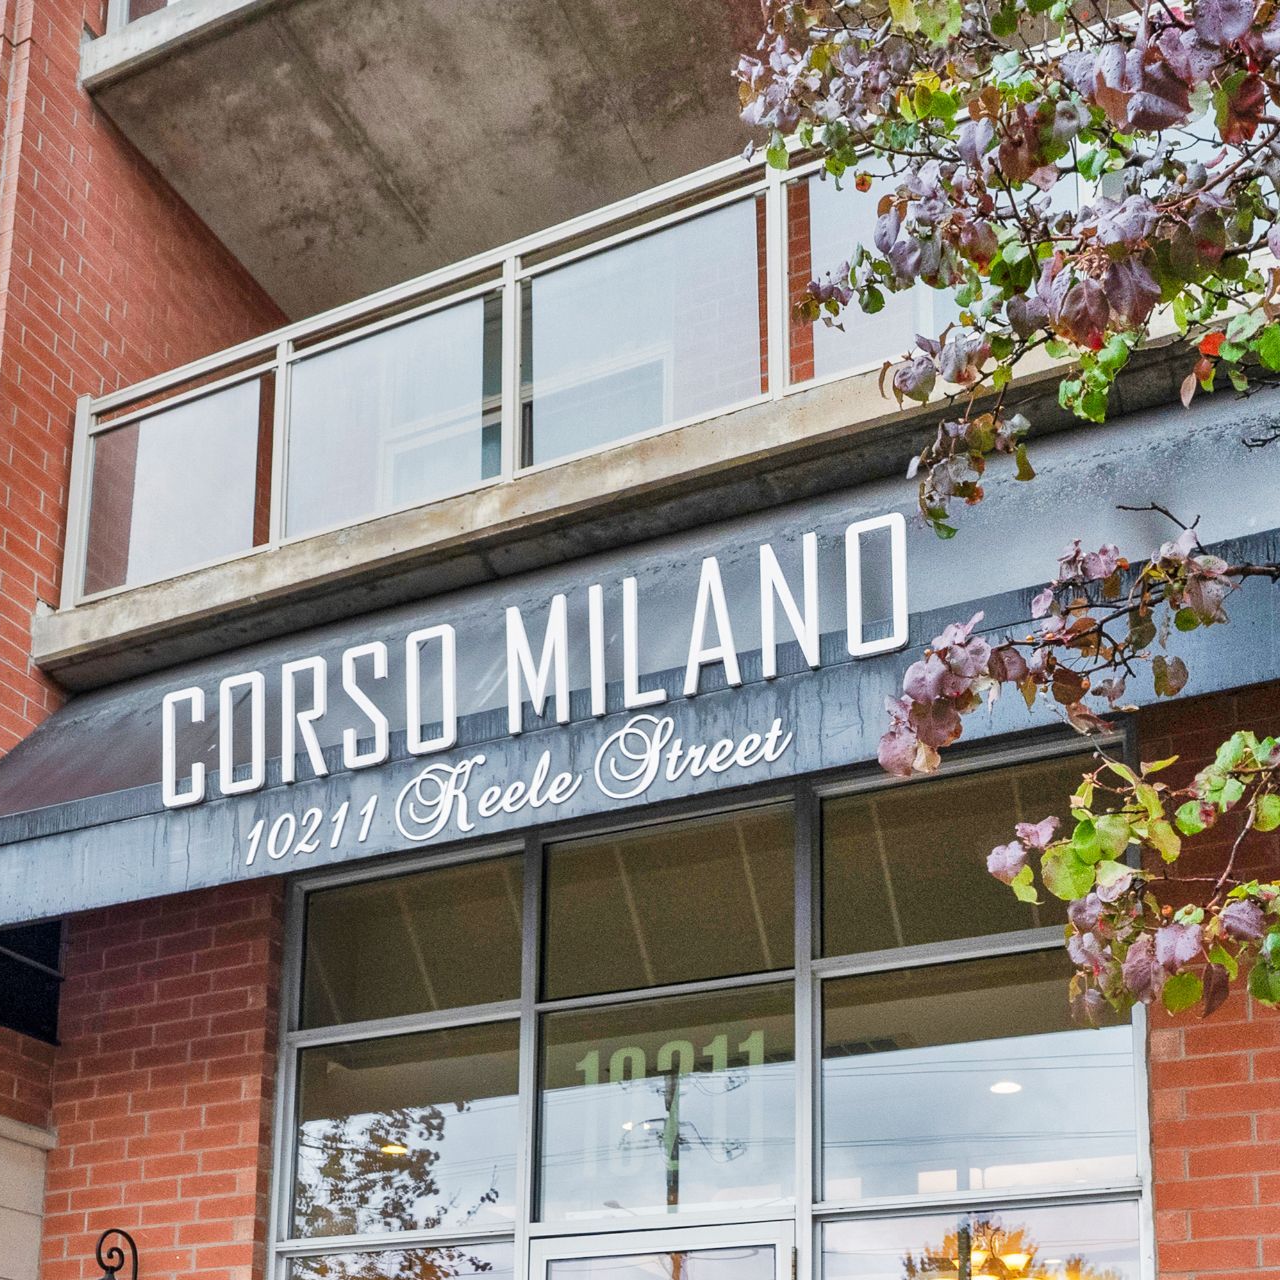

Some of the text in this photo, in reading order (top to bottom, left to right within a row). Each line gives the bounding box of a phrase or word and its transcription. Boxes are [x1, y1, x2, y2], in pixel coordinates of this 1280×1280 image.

[162, 512, 909, 808] CORSO MILANO
[244, 714, 796, 867] 10211 Keele Street
